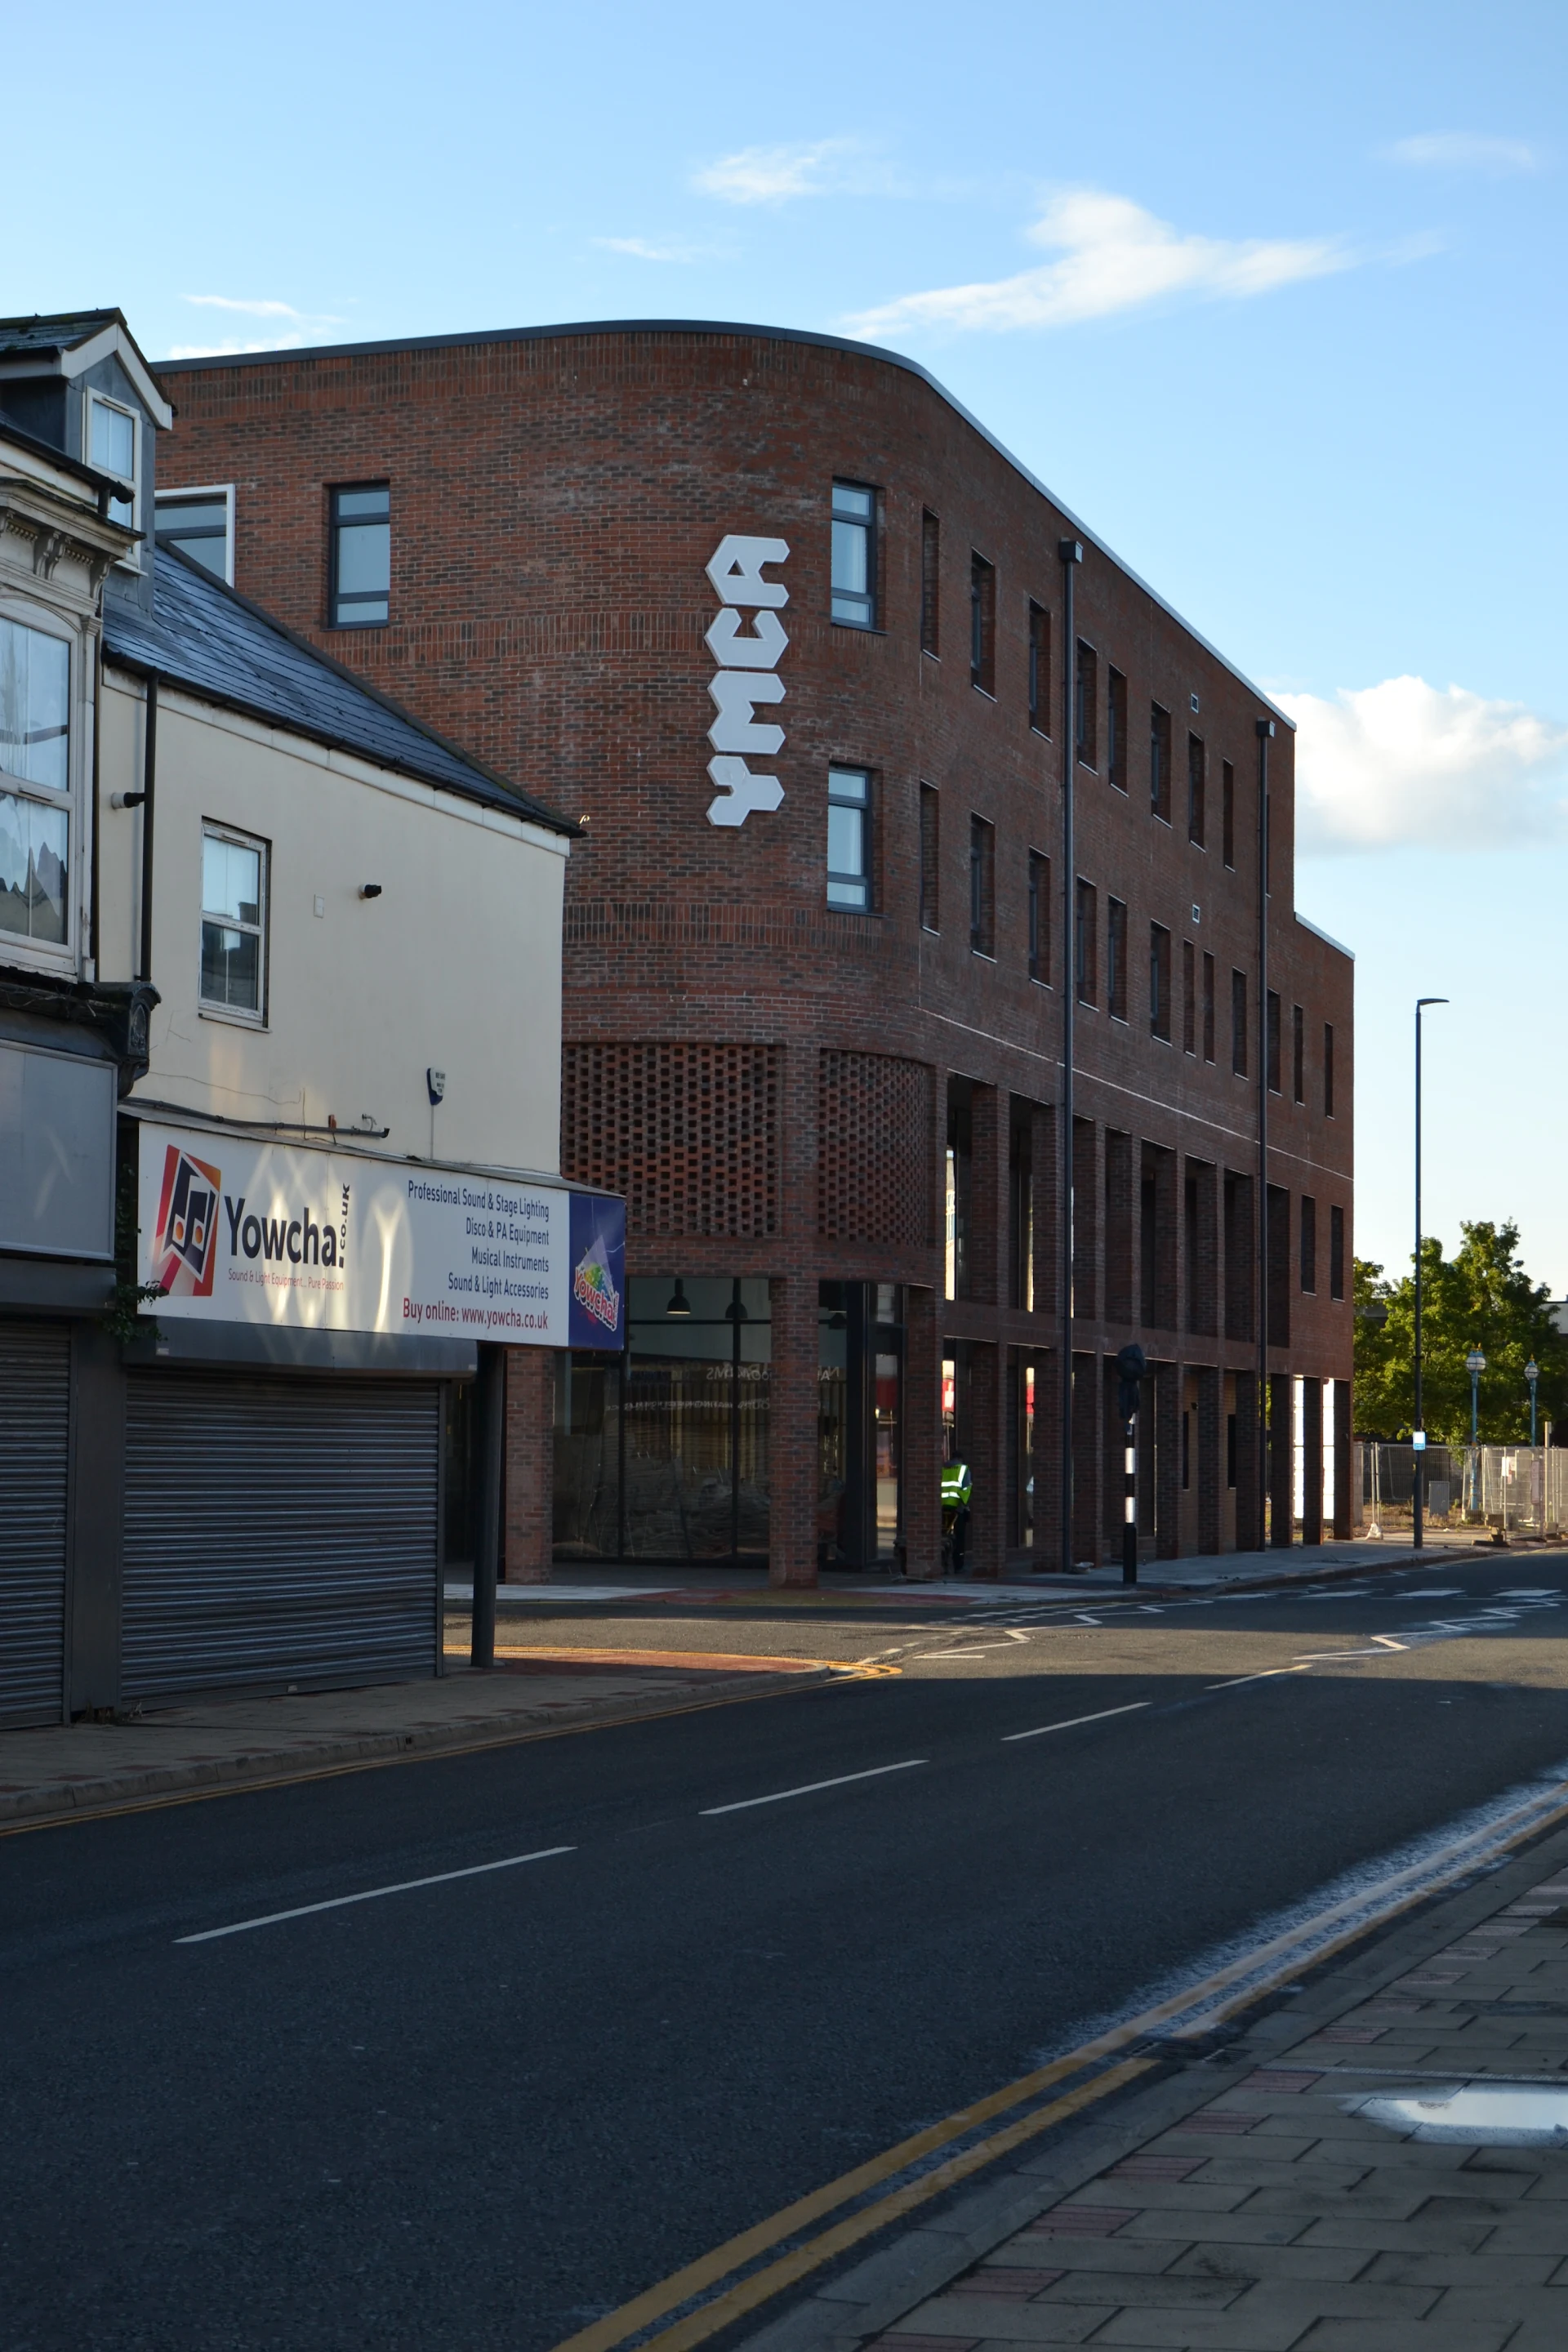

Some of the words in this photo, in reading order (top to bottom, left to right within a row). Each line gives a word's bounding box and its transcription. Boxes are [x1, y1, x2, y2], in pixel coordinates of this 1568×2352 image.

[705, 534, 790, 826] YMCA
[408, 1180, 461, 1205] Professional
[462, 1188, 486, 1209] Sound
[488, 1192, 494, 1210] &
[496, 1194, 518, 1218] Stage
[519, 1197, 549, 1223] Lighting
[224, 1195, 336, 1267] Yowcha
[466, 1217, 486, 1236] Disco
[488, 1221, 494, 1238] &
[497, 1222, 507, 1240] PA
[510, 1223, 549, 1247] Equipment
[472, 1246, 501, 1267] Musical
[503, 1250, 549, 1272] Instruments
[228, 1267, 248, 1282] Sound
[249, 1271, 254, 1283] &
[255, 1272, 270, 1287] Light
[308, 1276, 321, 1290] Pure
[322, 1278, 344, 1291] Passion
[448, 1272, 472, 1292] Sound
[474, 1275, 479, 1293] &
[482, 1276, 502, 1298] Light
[504, 1278, 549, 1300] Accessories
[403, 1297, 423, 1324] Buy
[425, 1299, 459, 1322] online:
[461, 1307, 548, 1330] www.yowcha.co.uk
